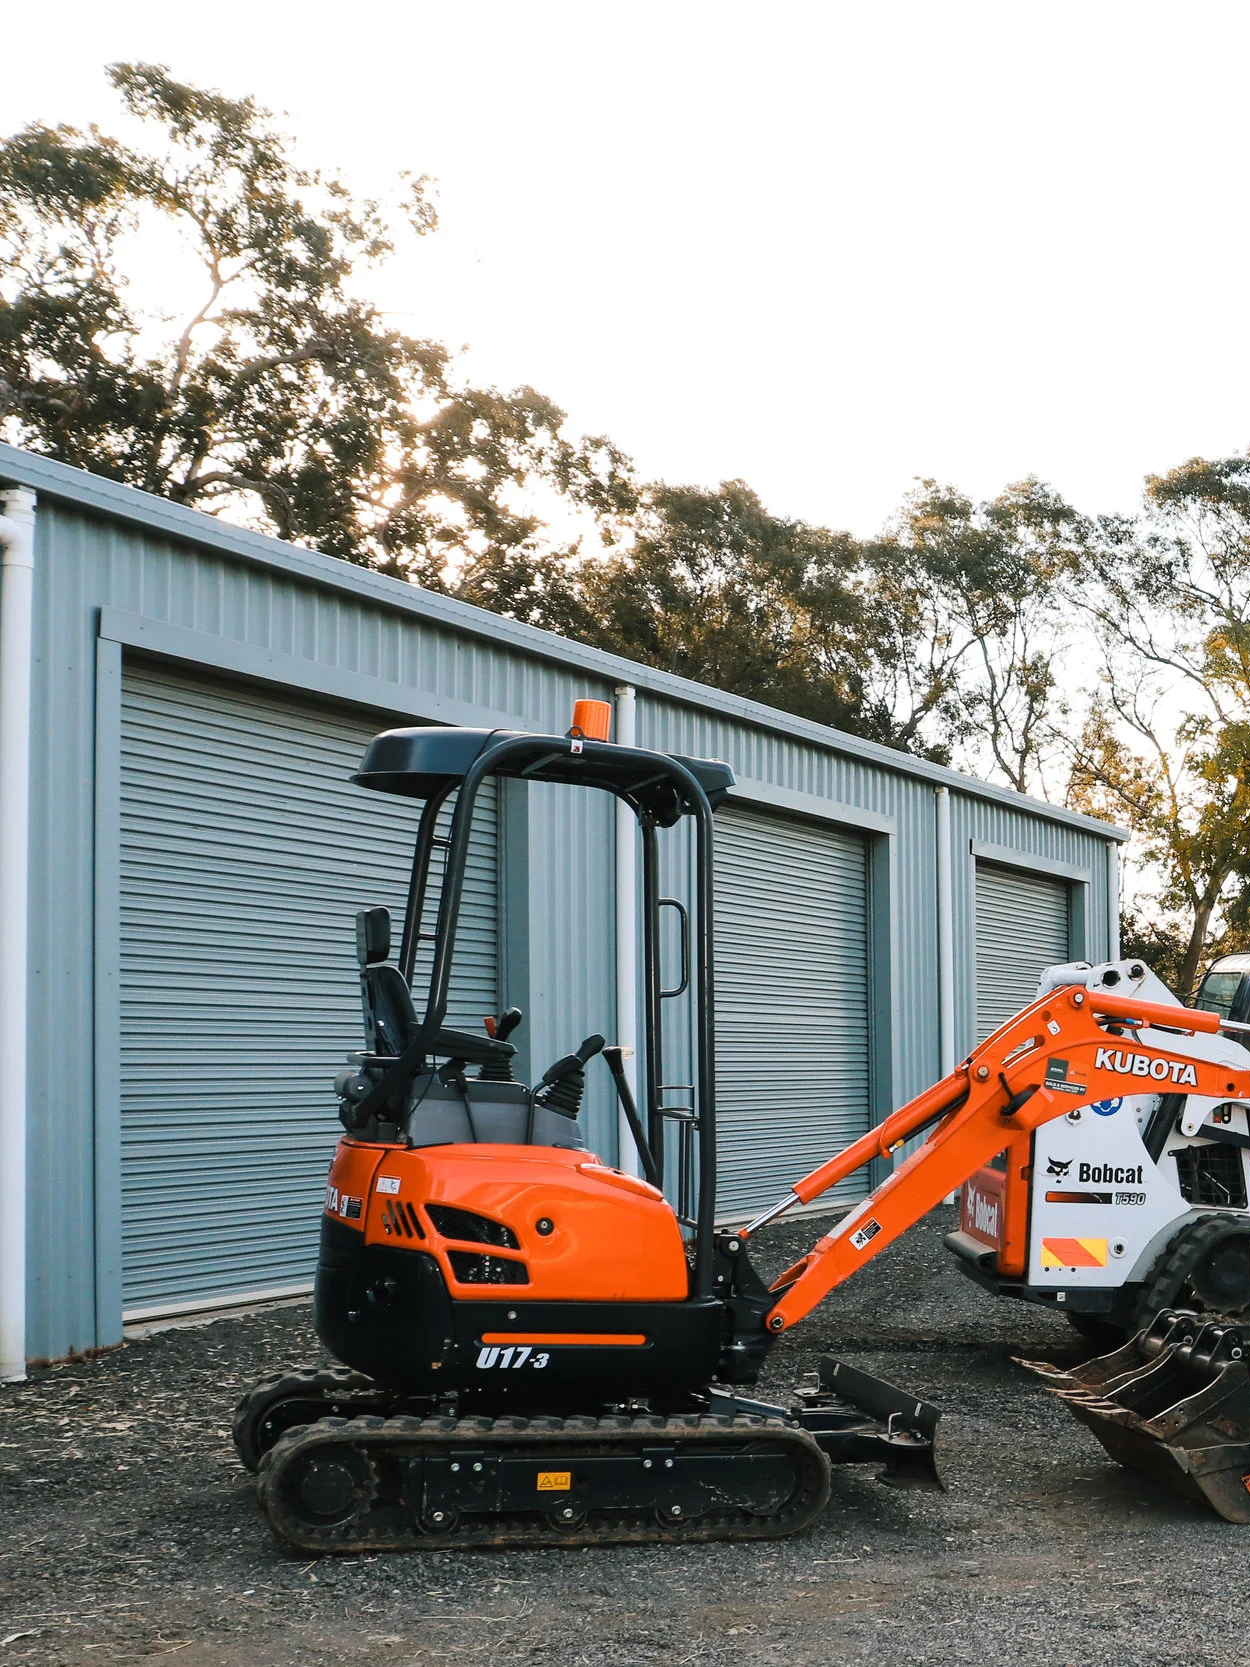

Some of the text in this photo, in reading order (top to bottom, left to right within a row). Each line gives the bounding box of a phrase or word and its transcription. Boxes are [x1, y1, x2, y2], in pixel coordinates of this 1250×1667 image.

[1095, 1047, 1198, 1087] KUBOTA
[1078, 1162, 1143, 1184] Bobcat
[1115, 1192, 1146, 1205] T590
[475, 1346, 550, 1369] U17-3
